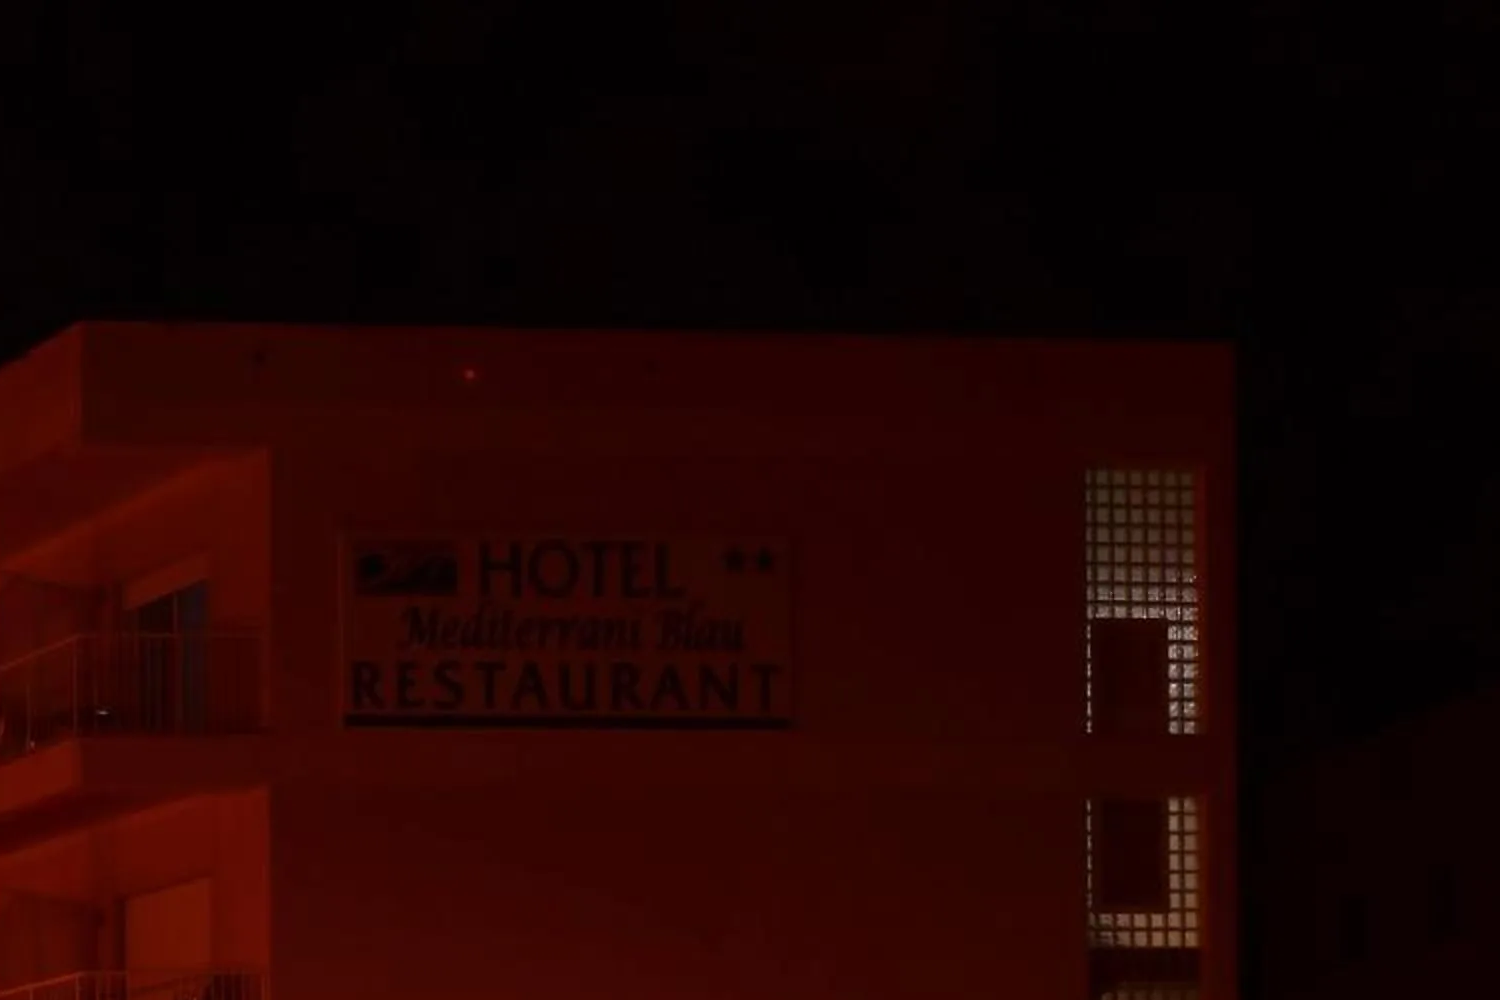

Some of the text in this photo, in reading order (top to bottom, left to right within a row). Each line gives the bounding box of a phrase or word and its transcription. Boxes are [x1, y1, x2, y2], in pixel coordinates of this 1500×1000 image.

[479, 538, 687, 599] HOTEL
[402, 600, 746, 652] Mediterrani Blau
[351, 660, 785, 711] RESTAURANT
